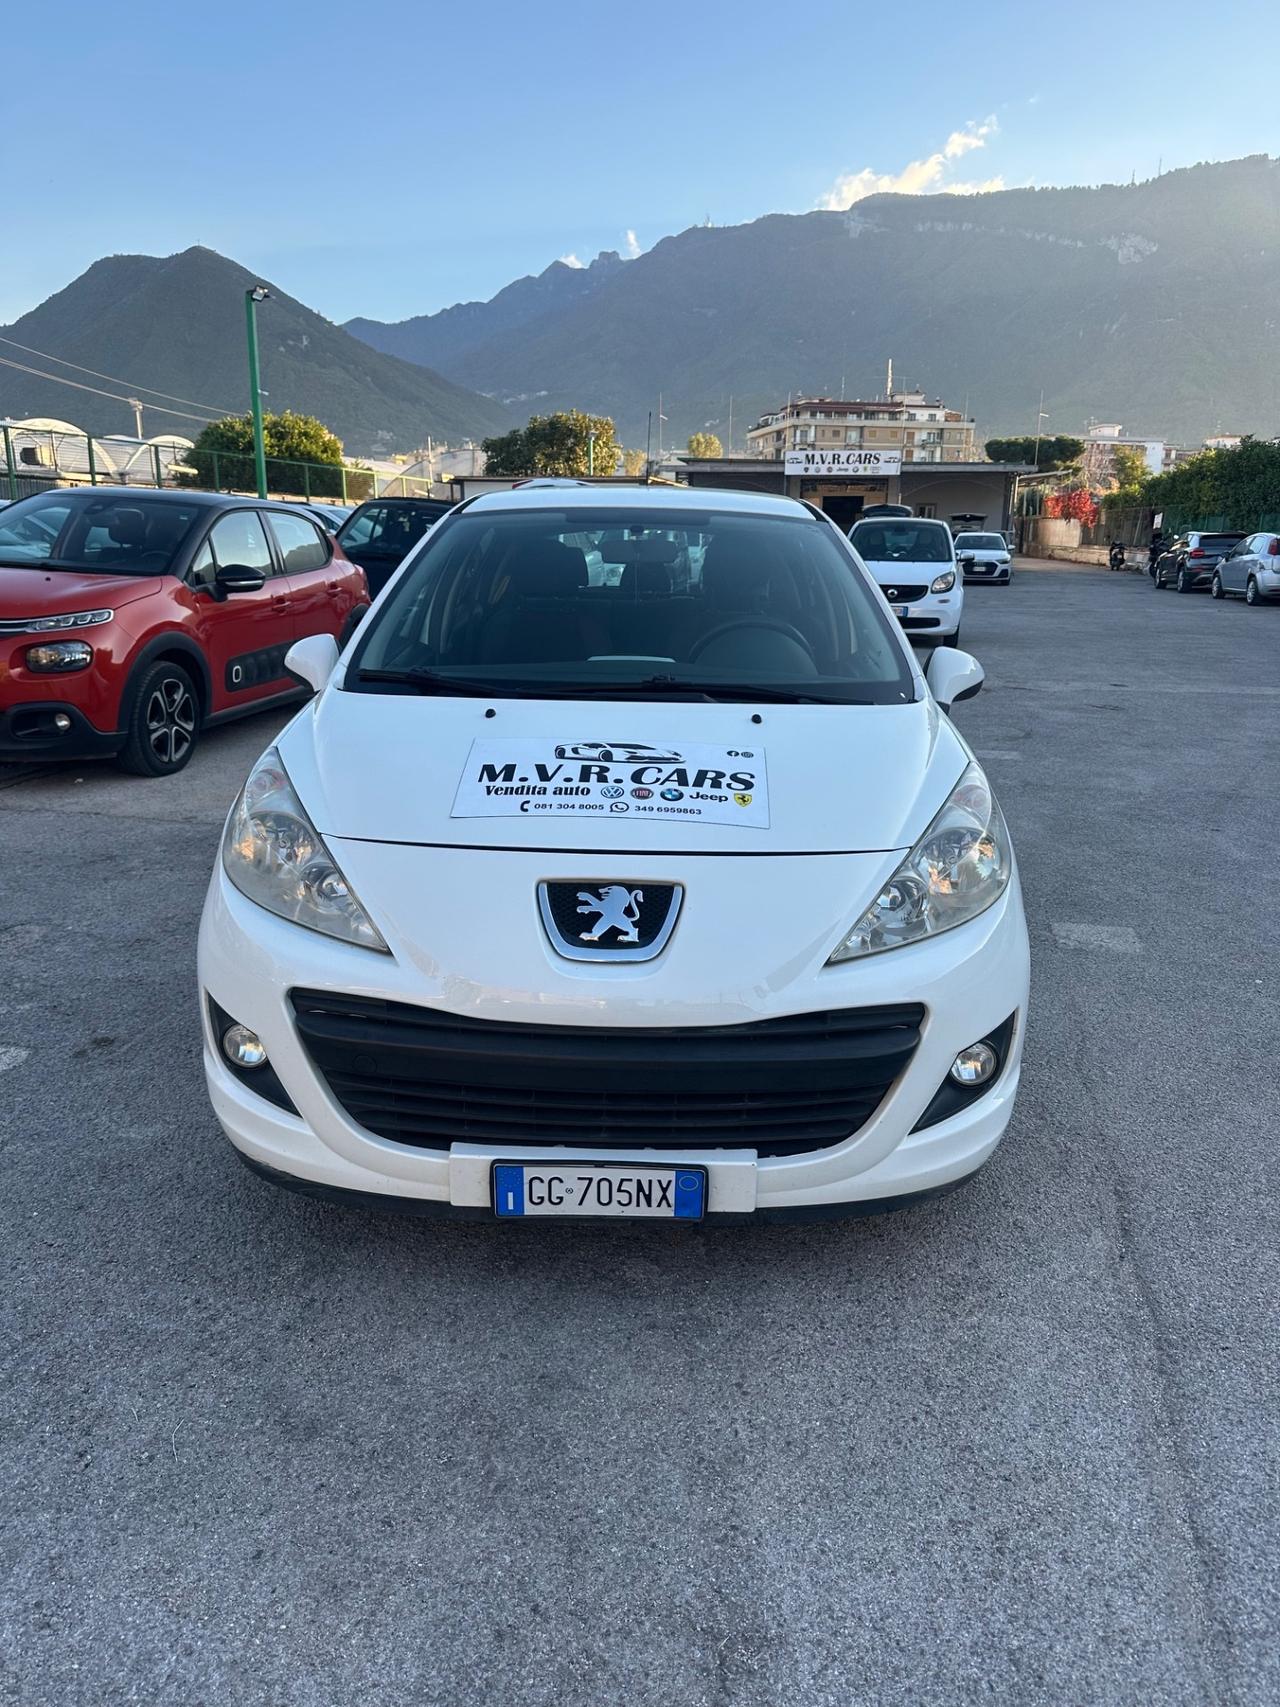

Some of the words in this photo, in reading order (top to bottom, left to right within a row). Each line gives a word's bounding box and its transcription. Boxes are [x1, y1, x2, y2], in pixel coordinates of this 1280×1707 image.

[485, 785, 547, 796] Vendita
[553, 785, 591, 796] auto
[689, 791, 729, 803] Jeep
[656, 806, 702, 815] 6959863
